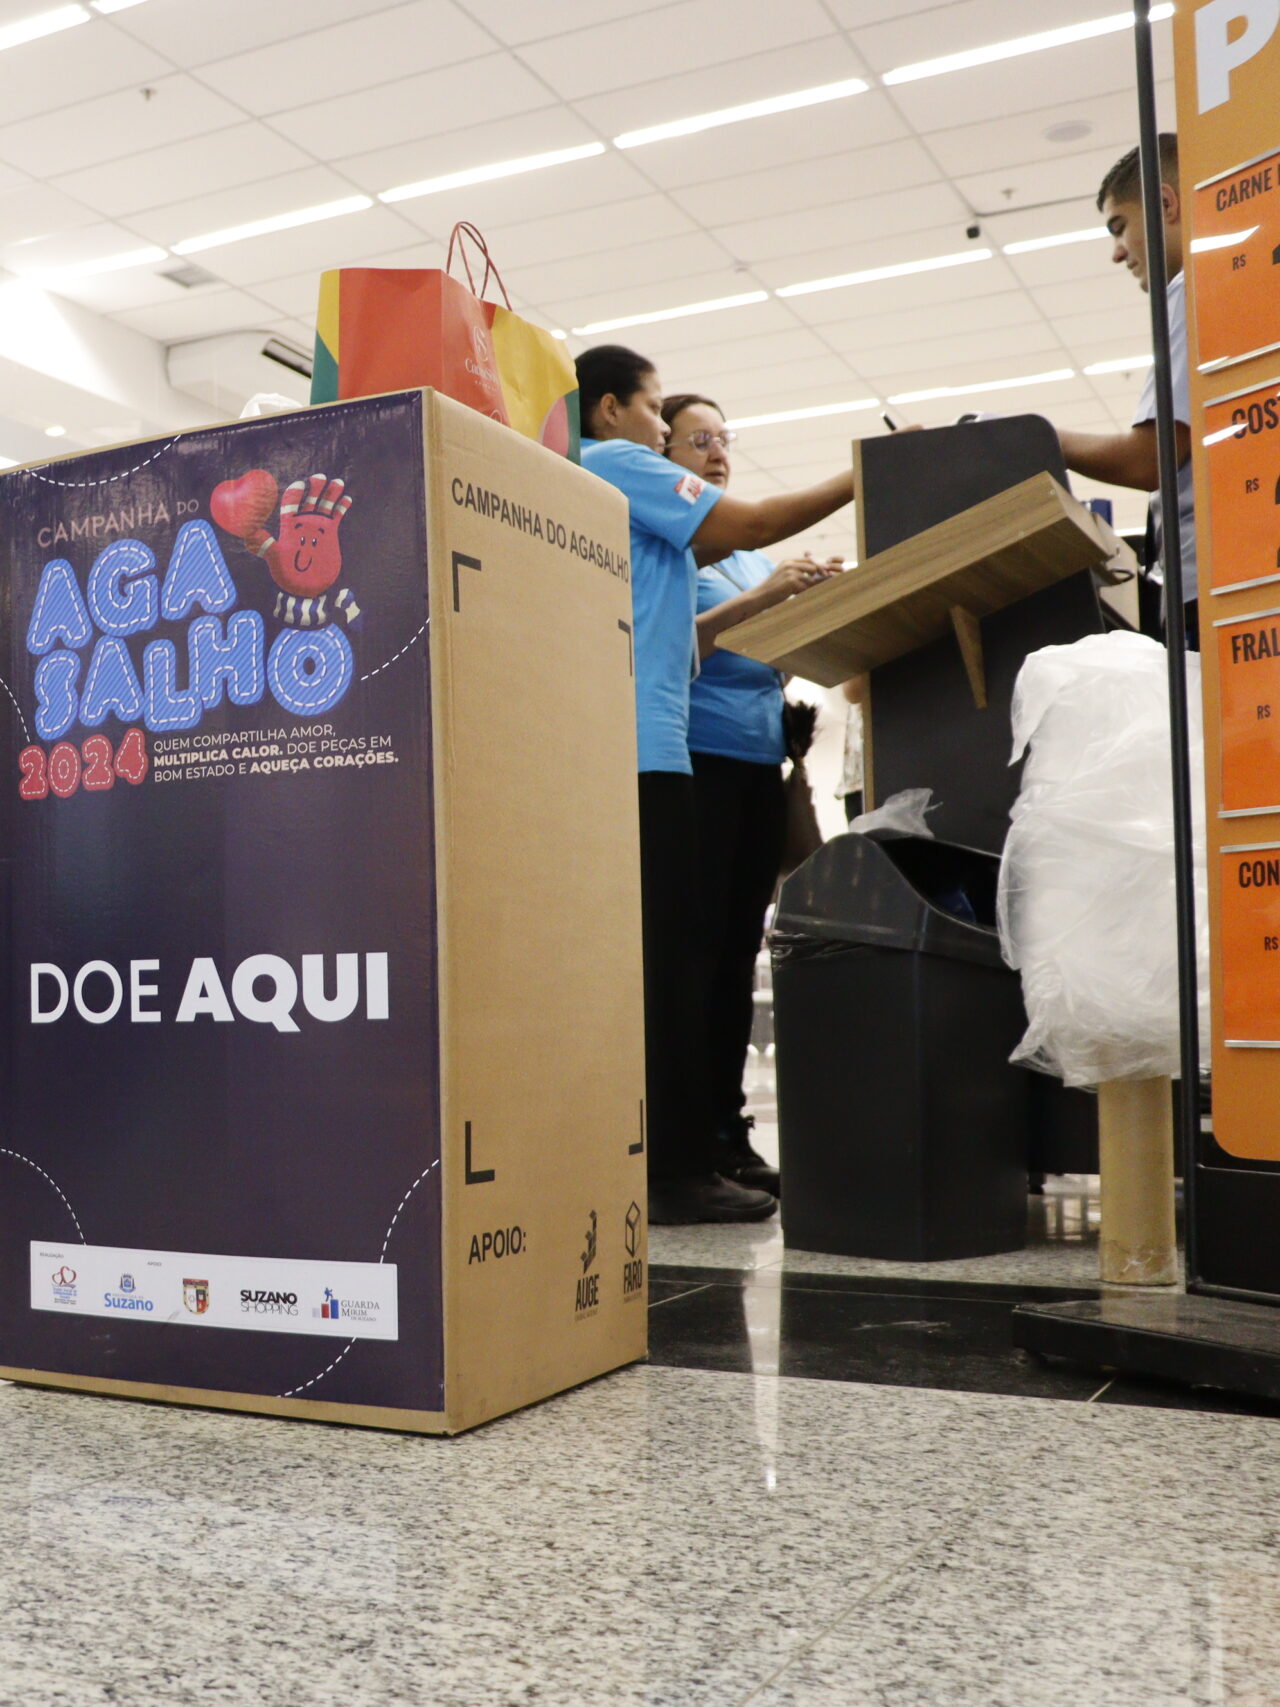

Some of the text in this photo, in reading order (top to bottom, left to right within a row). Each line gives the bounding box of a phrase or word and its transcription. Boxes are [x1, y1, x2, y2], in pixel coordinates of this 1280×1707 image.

[1216, 167, 1273, 212] CARNE
[1231, 397, 1280, 439] COS
[37, 499, 200, 548] CAMPANHA DO
[451, 477, 629, 584] CAMPANHA DO AGASALHO
[26, 519, 237, 655] AGA
[34, 609, 354, 741] SALHO
[154, 724, 336, 752] QUEM COMPARTILHA AMOR,
[154, 735, 392, 768] MULTIPLICA CALOR. DOE PEÇAS EM
[19, 728, 148, 800] 2024
[154, 749, 399, 783] BOM ESTADO E AQUEÇA CORAÇÕES.
[31, 952, 389, 1032] DOE AQUI
[468, 1226, 526, 1265] APOIO:
[575, 1274, 600, 1312] AUGE
[623, 1259, 642, 1294] FARO
[104, 1292, 154, 1311] Suzano
[240, 1289, 298, 1305] SUZANO
[240, 1301, 299, 1316] SHOPPING
[341, 1300, 380, 1310] GUARDA
